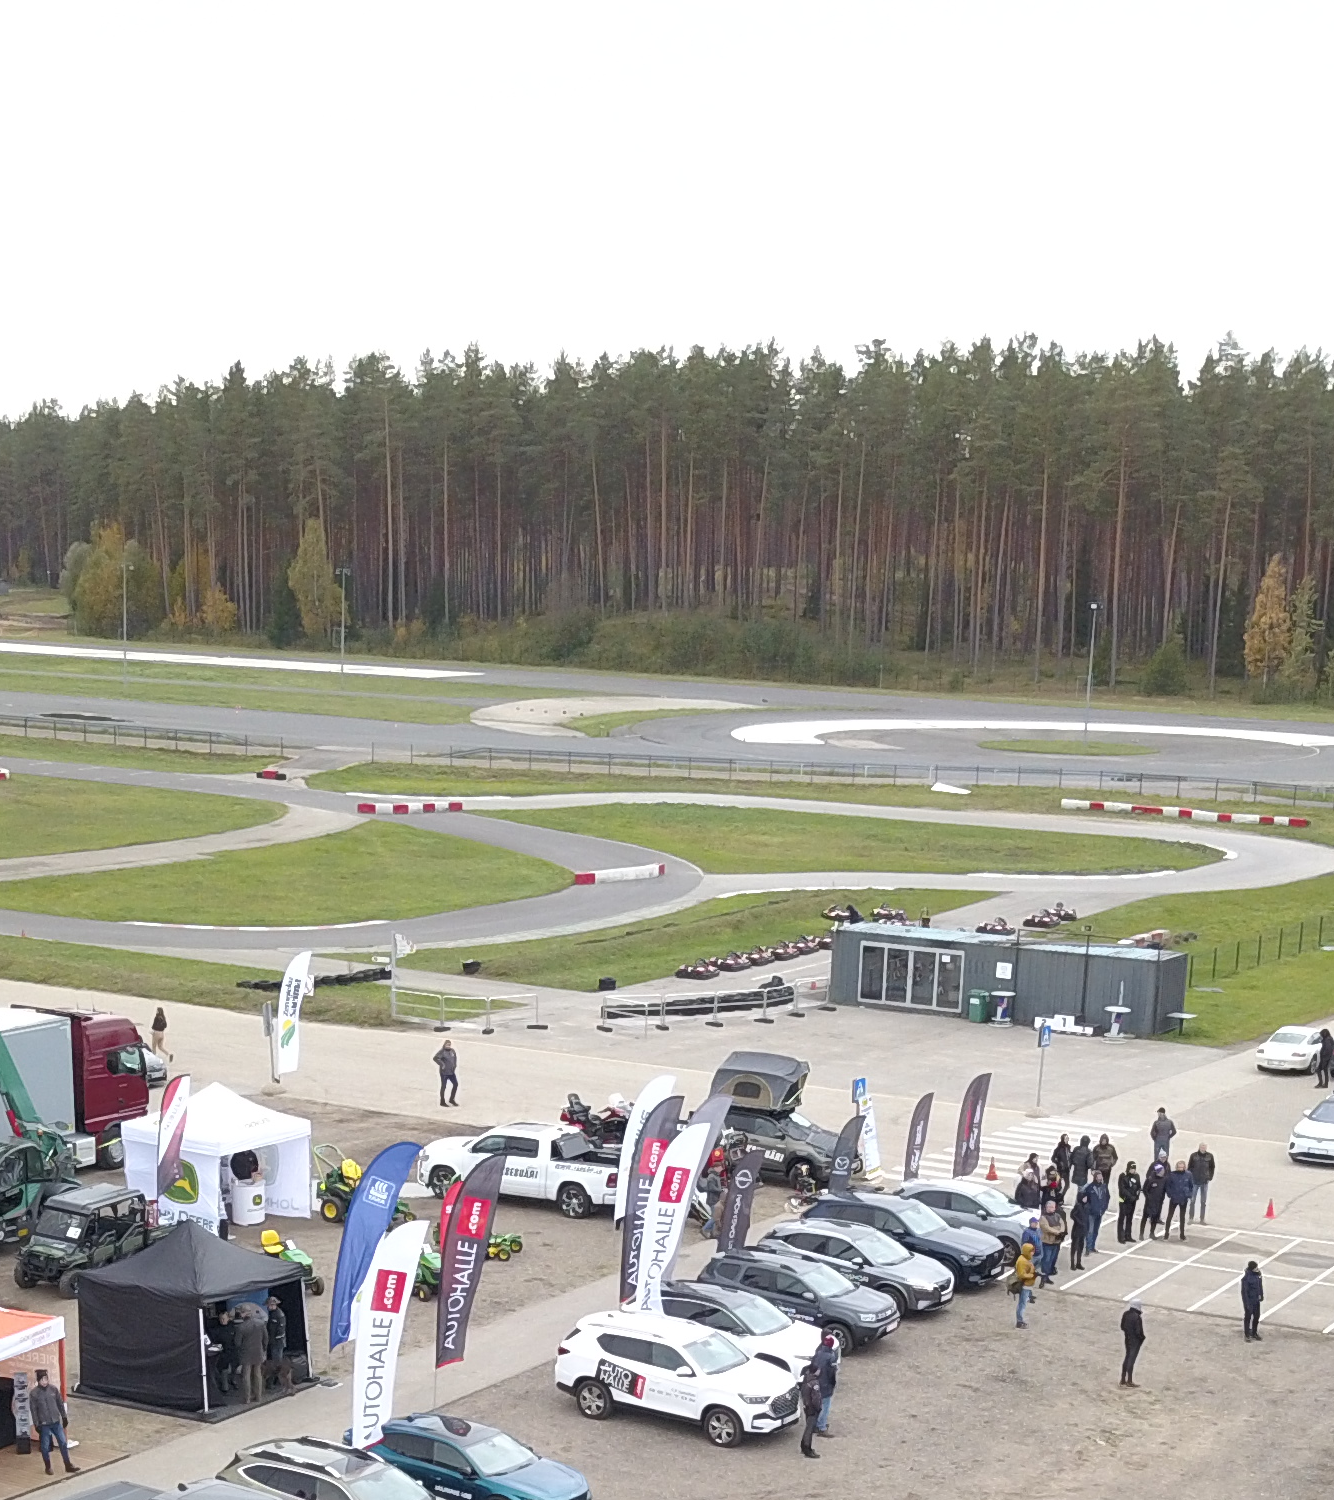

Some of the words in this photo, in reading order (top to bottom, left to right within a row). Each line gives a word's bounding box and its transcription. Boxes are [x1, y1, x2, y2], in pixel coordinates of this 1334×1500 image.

[669, 1169, 683, 1201] .com
[385, 1273, 398, 1309] .com
[444, 1240, 477, 1350] AUTOHALLE
[471, 1201, 482, 1234] .com
[599, 1371, 630, 1392] HALLE
[600, 1362, 632, 1382] AUTO
